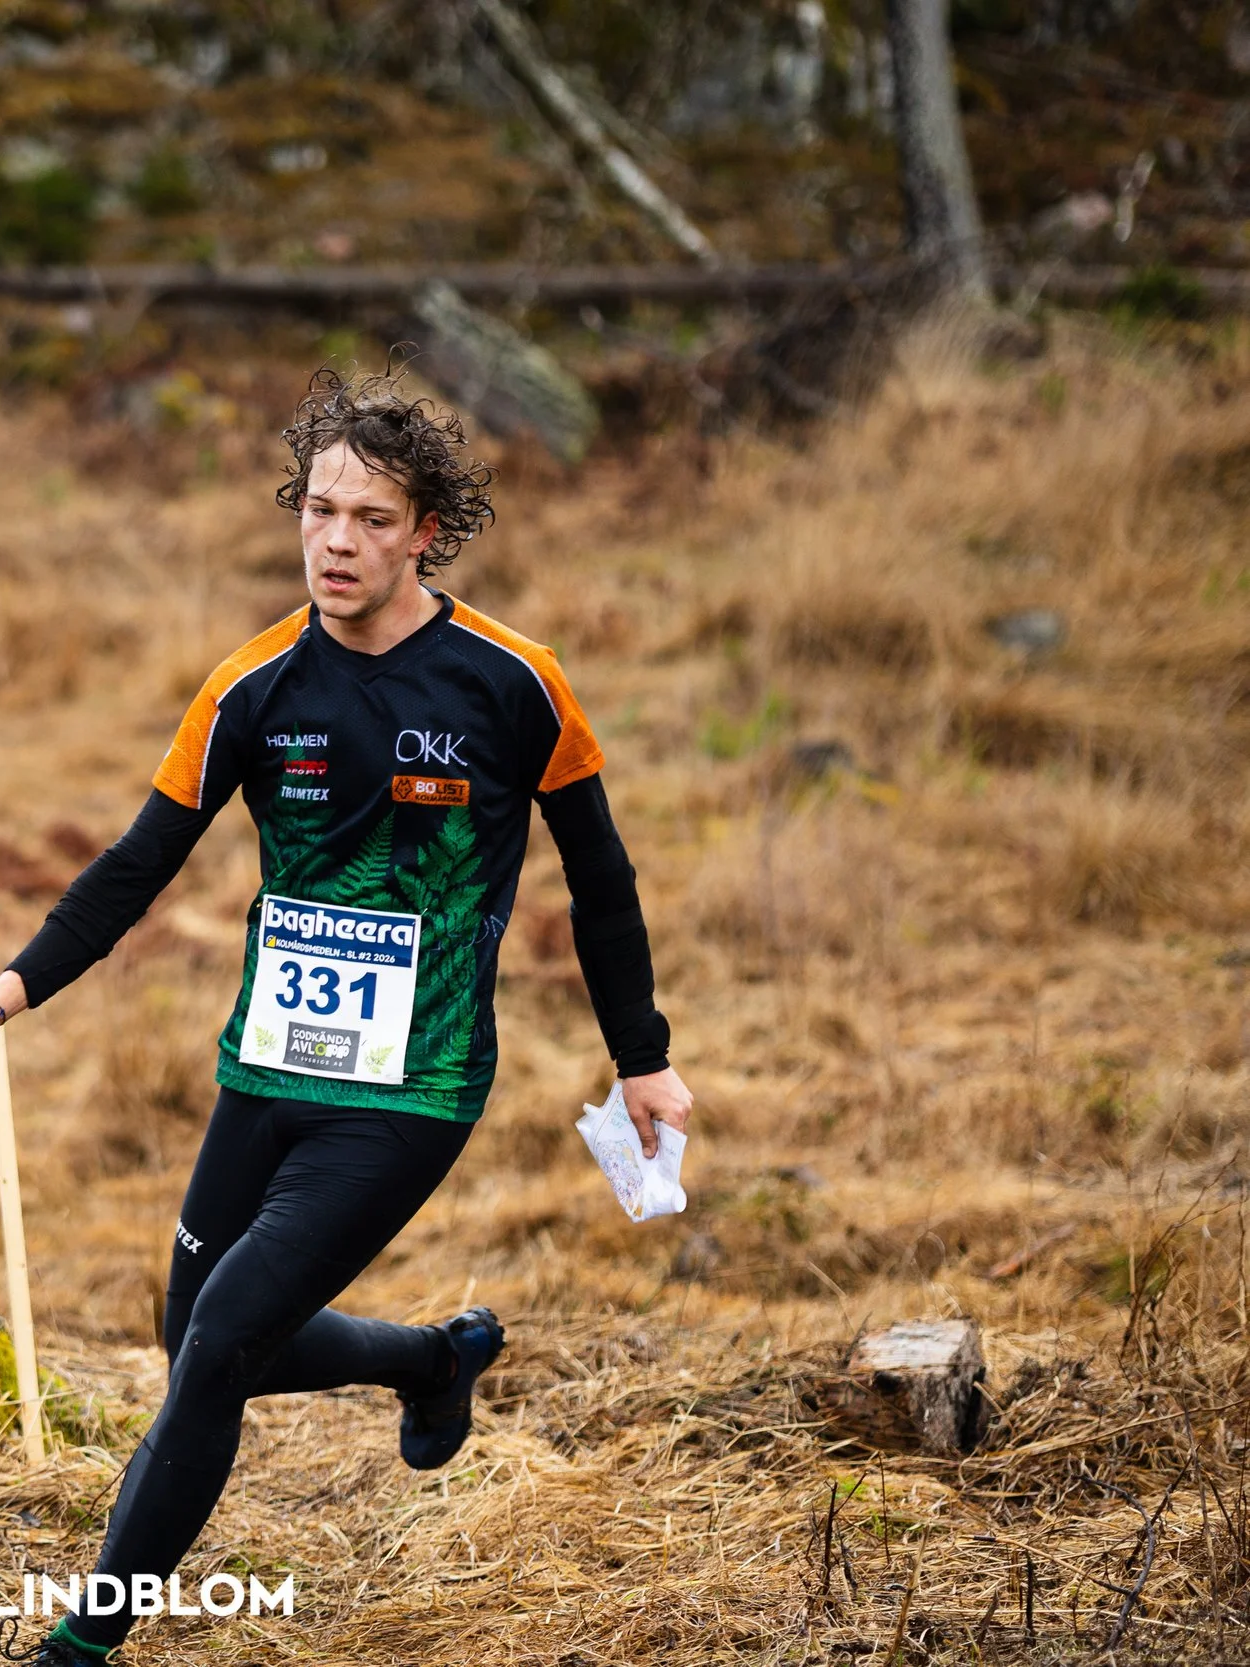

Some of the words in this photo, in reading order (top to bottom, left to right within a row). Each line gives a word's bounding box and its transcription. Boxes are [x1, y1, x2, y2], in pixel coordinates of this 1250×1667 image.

[266, 734, 328, 747] HOLMEN
[396, 729, 468, 767] OKK
[281, 785, 330, 801] TRIMTEX
[415, 780, 465, 797] BOLIST
[265, 901, 414, 947] bagheera
[275, 939, 340, 957] KOLMÅRDSMEDELN
[346, 950, 357, 960] SL
[358, 951, 371, 961] #2
[373, 953, 396, 963] 2026
[275, 960, 378, 1020] 331
[292, 1028, 352, 1046] GODKÄNDA
[300, 1056, 330, 1066] SVERIGE
